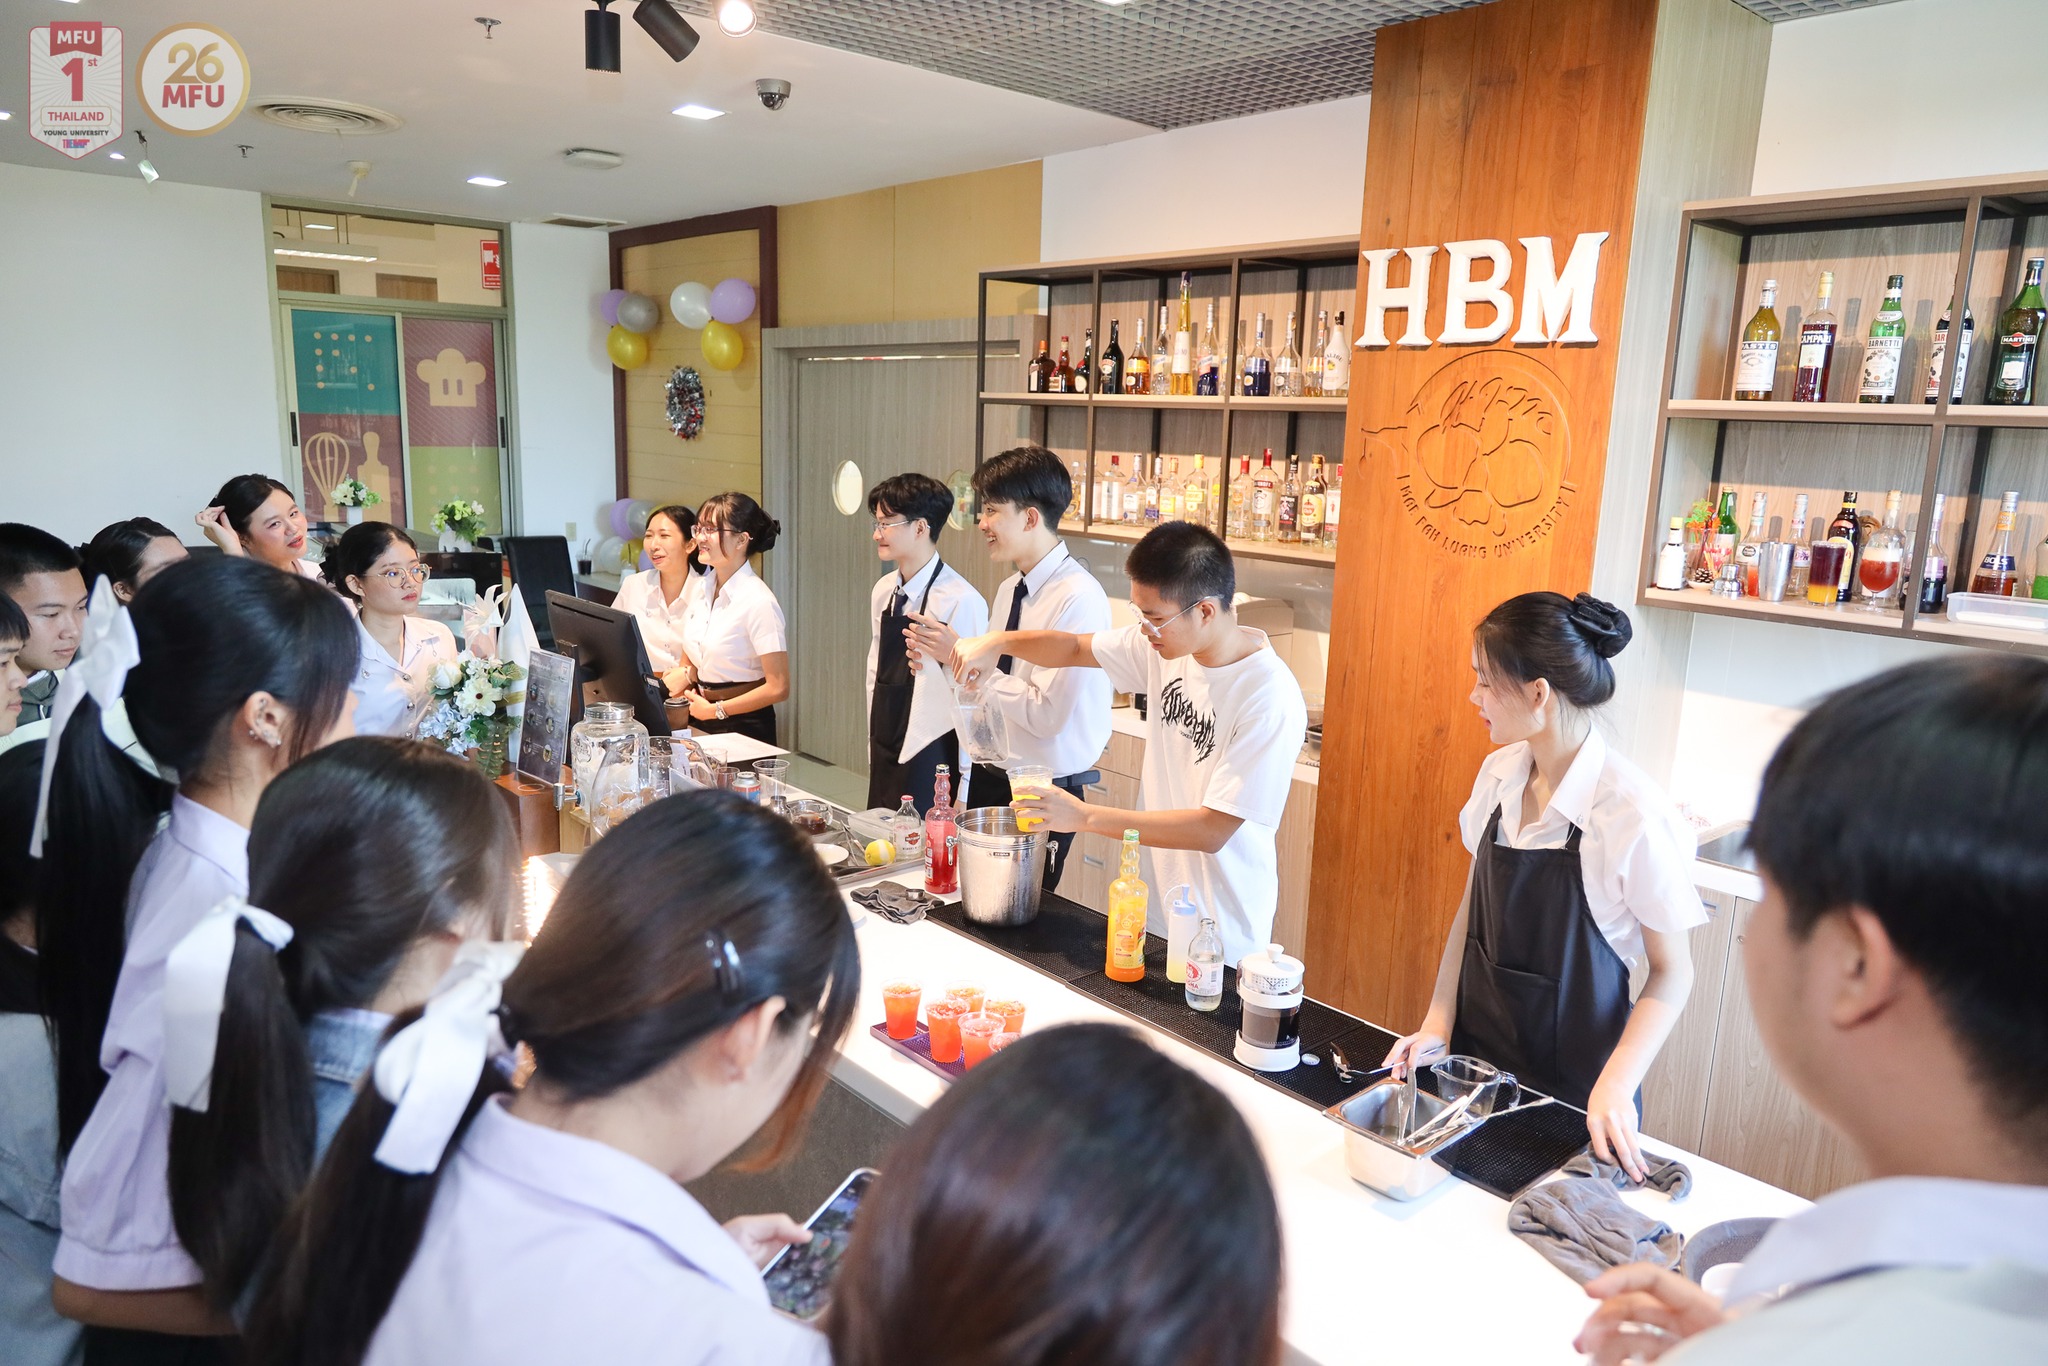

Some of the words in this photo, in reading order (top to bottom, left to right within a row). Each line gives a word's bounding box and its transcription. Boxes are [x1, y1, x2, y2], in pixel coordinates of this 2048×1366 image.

[1354, 231, 1611, 348] HBM
[1800, 334, 1832, 344] CAMPARI
[1868, 339, 1900, 348] BARNETTI
[1415, 515, 1441, 542] FAH
[1441, 536, 1488, 560] LUANG
[1493, 496, 1570, 559] UNIVERSITY
